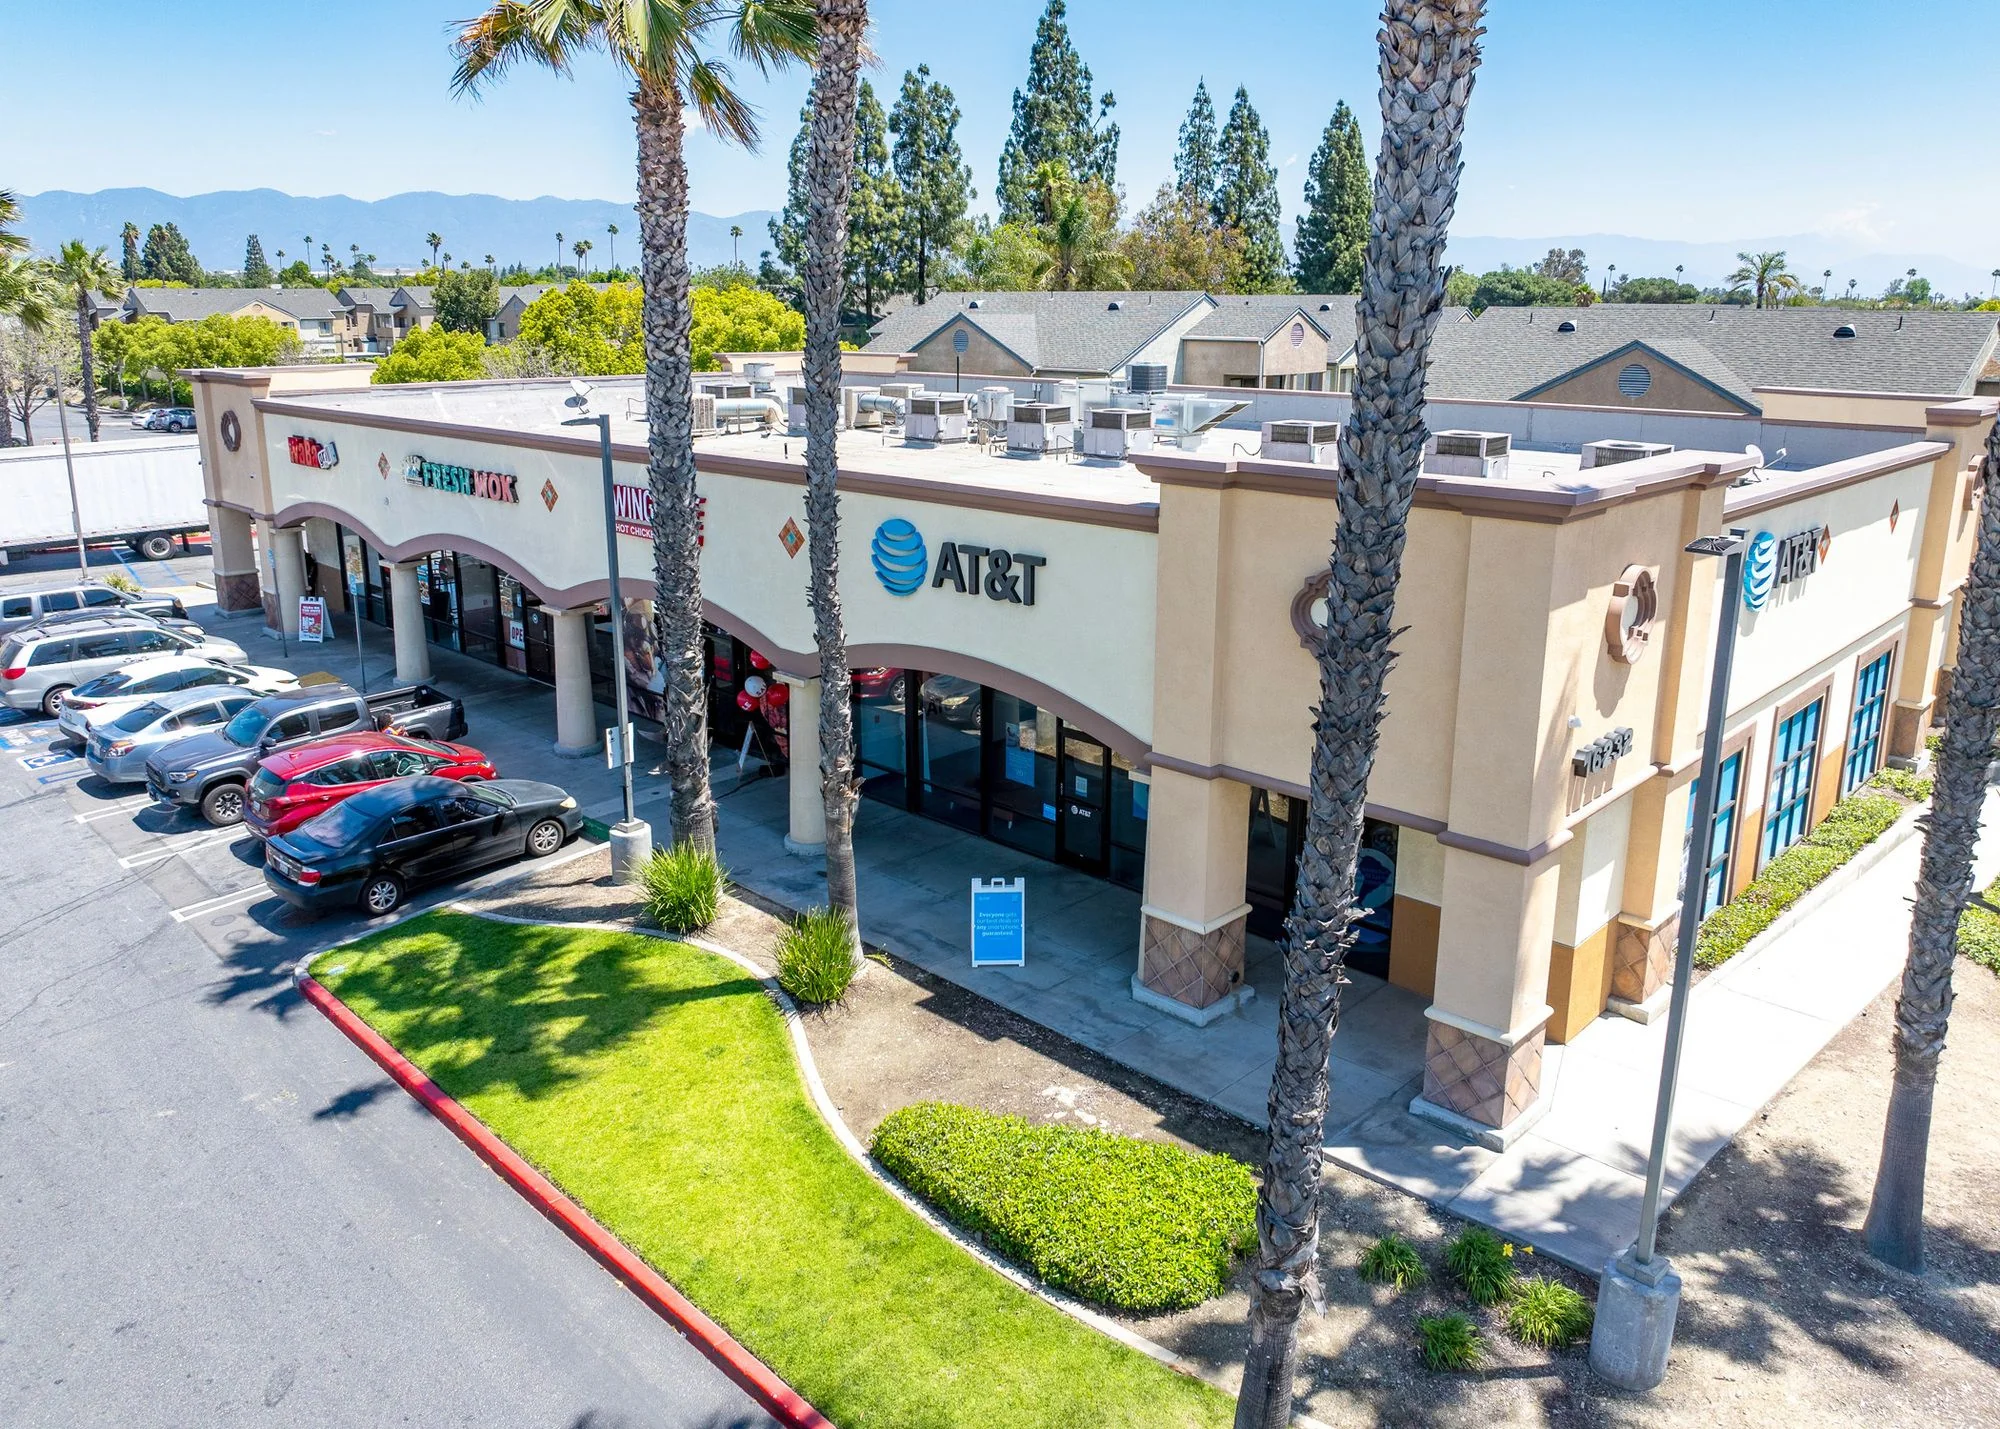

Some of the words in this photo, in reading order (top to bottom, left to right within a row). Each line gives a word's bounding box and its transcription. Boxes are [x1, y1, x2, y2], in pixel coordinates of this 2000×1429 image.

[421, 461, 473, 496] FRESH
[473, 471, 519, 503] WOK
[615, 523, 629, 533] HOT
[931, 541, 1047, 606] AT&T
[1772, 528, 1824, 588] AT&T
[511, 626, 524, 642] OPE
[1572, 727, 1634, 777] 16232
